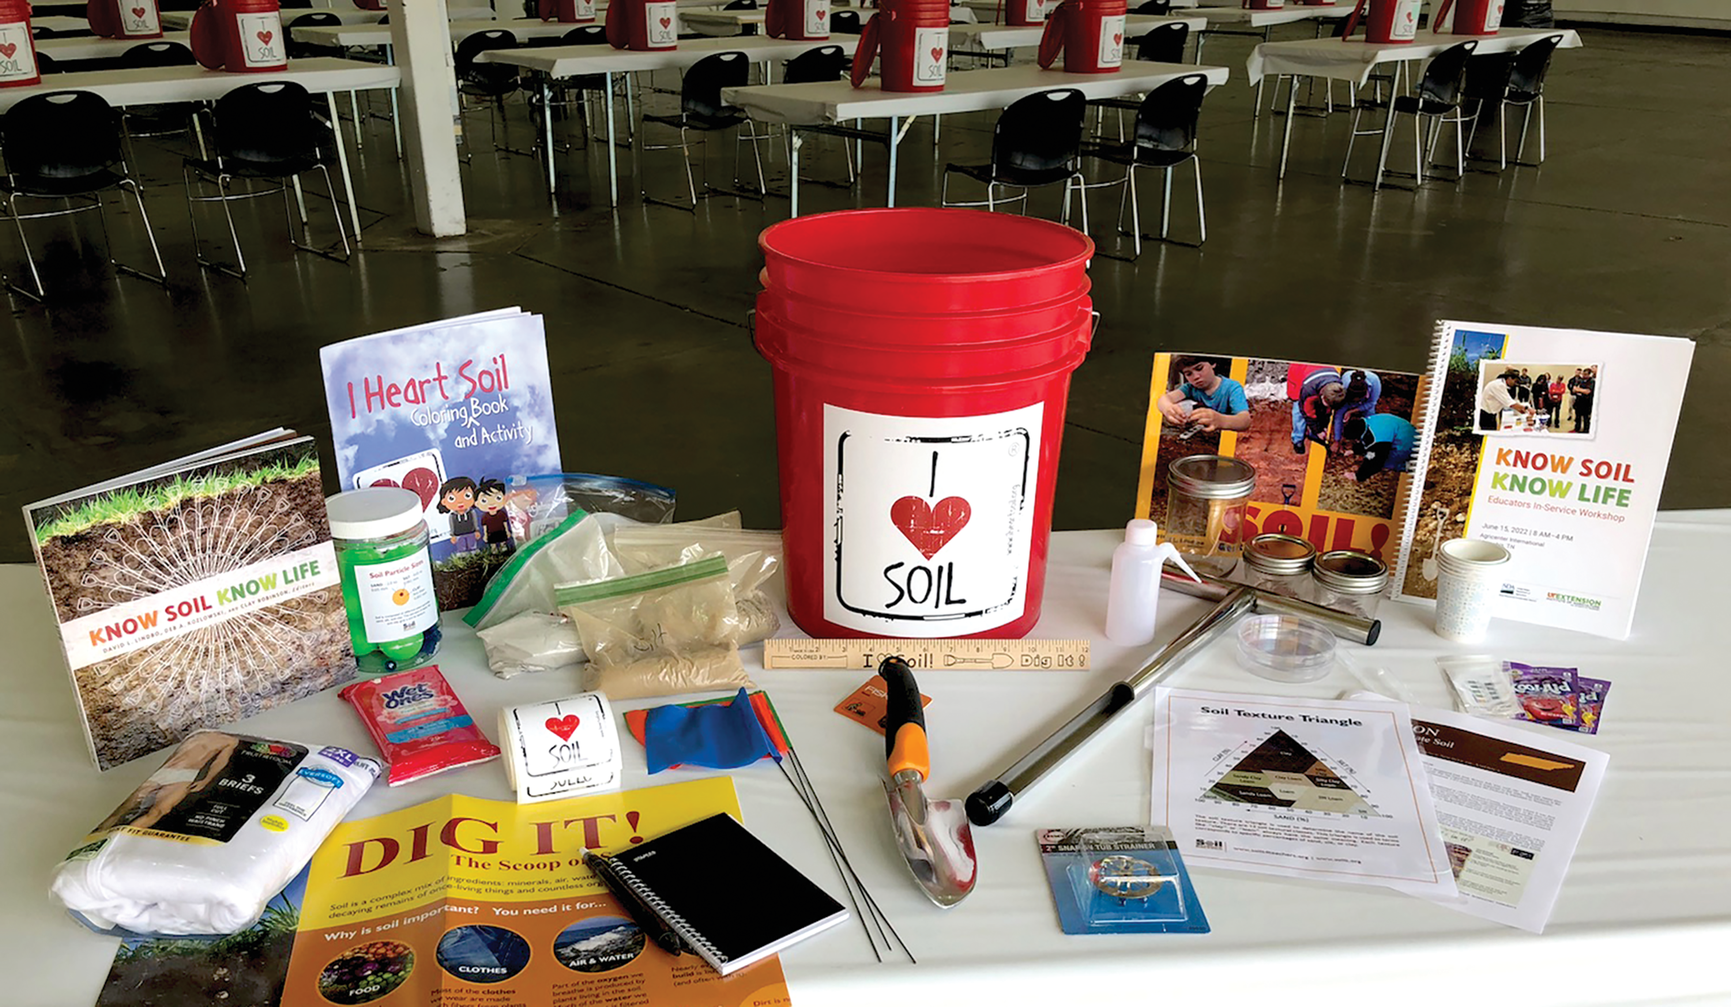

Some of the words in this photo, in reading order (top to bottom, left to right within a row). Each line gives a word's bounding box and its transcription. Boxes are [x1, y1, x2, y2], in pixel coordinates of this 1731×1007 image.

[132, 18, 149, 29] SOIL
[658, 30, 672, 41] SOIL
[256, 46, 277, 59] SOIL
[347, 382, 356, 420] I
[364, 362, 449, 413] Heart
[458, 353, 509, 399] Soil
[410, 406, 468, 429] Coloring
[471, 395, 509, 418] Book
[454, 429, 477, 449] and
[481, 421, 534, 445] Activity
[1495, 447, 1574, 474] KNOW
[1578, 458, 1635, 483] SOIL
[929, 450, 939, 498] I
[1491, 471, 1573, 499] KNOW
[1577, 483, 1632, 508] LIFE
[1487, 495, 1531, 509] Educators
[1533, 502, 1577, 515] In-Service
[1579, 508, 1625, 523] Workshop
[1232, 506, 1390, 559] SOIL!
[1511, 527, 1528, 535] 2022
[1510, 537, 1545, 547] International
[385, 566, 410, 577] Particle
[883, 561, 967, 609] SOIL
[89, 610, 158, 646] KNOW
[165, 595, 213, 622] SOIL
[217, 572, 278, 605] KNOW
[282, 560, 321, 585] LIFE
[1556, 593, 1602, 606] EXTENSION
[103, 643, 125, 653] DAVID
[240, 601, 256, 609] CLAY
[862, 654, 873, 668] I
[1020, 654, 1052, 669] Dig
[382, 683, 428, 701] Wet
[385, 691, 434, 709] Ones
[1200, 706, 1229, 716] Soil
[1234, 709, 1295, 721] Texture
[1299, 714, 1363, 727] Triangle
[1432, 738, 1455, 749] Soil
[549, 741, 588, 769] SOIL
[218, 778, 264, 795] BRIEFS
[241, 774, 256, 783] 3
[142, 830, 191, 841] GUARANTEE
[1196, 839, 1223, 847] Soil
[336, 816, 505, 878] DIG
[530, 811, 644, 856] IT!
[1113, 843, 1155, 851] STRAINER
[451, 855, 491, 870] The
[498, 859, 561, 872] Scoop
[329, 904, 372, 919] decaying
[375, 896, 414, 909] remains
[417, 890, 428, 899] of
[485, 887, 514, 896] things
[537, 883, 583, 893] countless
[330, 902, 349, 911] Soil
[370, 888, 412, 905] complex
[414, 882, 432, 892] mix
[447, 875, 505, 886] ingredients:
[324, 930, 357, 942] Why
[361, 927, 372, 935] is
[375, 919, 399, 932] soil
[403, 903, 479, 925] important?
[491, 906, 519, 916] You
[523, 904, 558, 916] need
[561, 903, 577, 913] it
[569, 958, 586, 967] AIR
[588, 957, 597, 965] &
[599, 952, 635, 963] WATER
[458, 965, 508, 975] CLOTHES
[596, 975, 629, 983] oxygen
[349, 984, 381, 997] FOOD
[552, 989, 584, 997] breathe
[595, 980, 634, 991] produced
[553, 997, 577, 1005] plants
[753, 997, 771, 1007] Dirt
